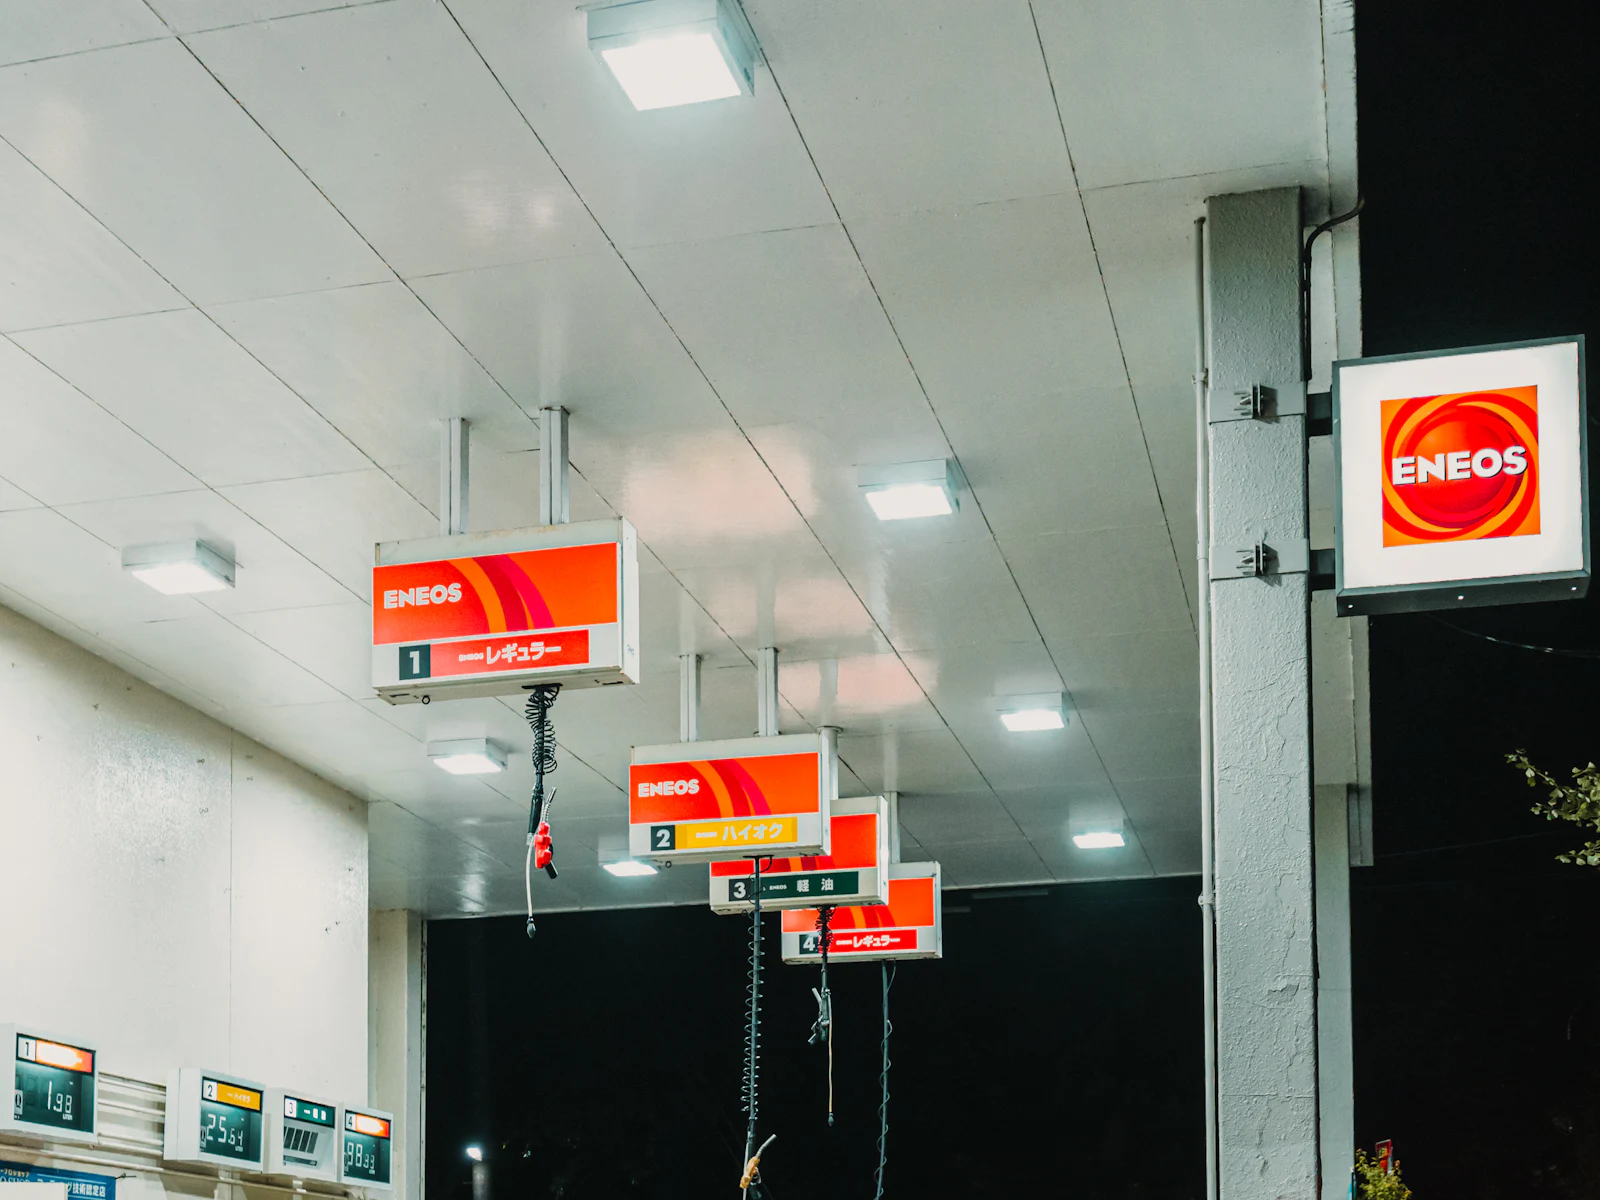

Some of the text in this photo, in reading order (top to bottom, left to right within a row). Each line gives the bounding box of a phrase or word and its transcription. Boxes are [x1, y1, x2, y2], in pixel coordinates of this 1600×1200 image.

[1392, 445, 1528, 486] ENEOS
[383, 582, 462, 609] ENEOS
[409, 641, 562, 675] 1 ENEOS レギュラー
[637, 778, 700, 798] ENEOS
[655, 829, 671, 848] 2
[721, 822, 783, 841] ハイオク
[733, 881, 747, 899] 3
[796, 878, 834, 893] 軽油
[802, 936, 816, 951] 4
[853, 934, 901, 948] レギュラー
[25, 1041, 30, 1057] 1
[207, 1084, 213, 1098] 2
[288, 1102, 294, 1114] 3
[347, 1115, 353, 1127] 4
